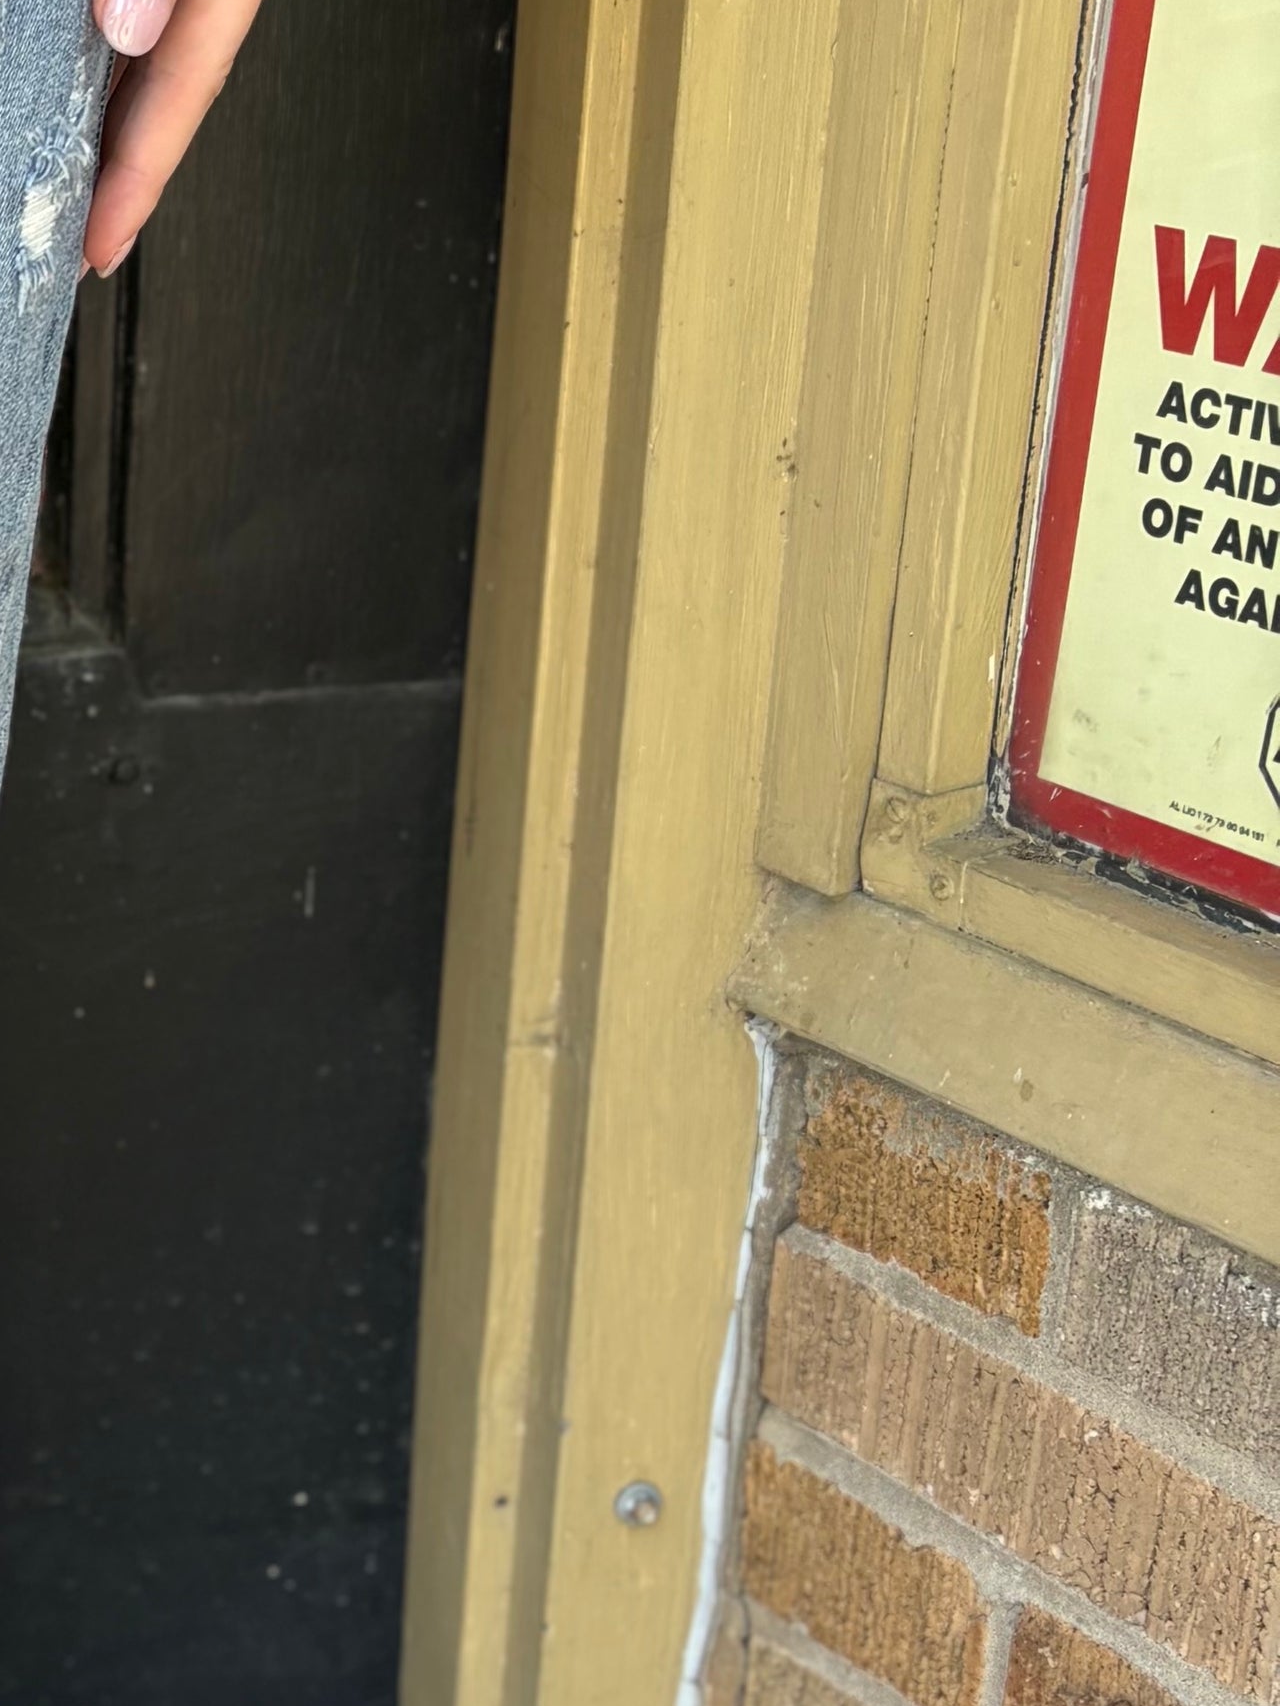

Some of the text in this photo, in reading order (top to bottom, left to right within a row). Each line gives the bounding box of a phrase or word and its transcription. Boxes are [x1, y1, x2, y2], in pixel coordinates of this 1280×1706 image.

[1154, 224, 1280, 376] W
[1134, 432, 1280, 506] TO AID
[1142, 497, 1280, 570] OF AN
